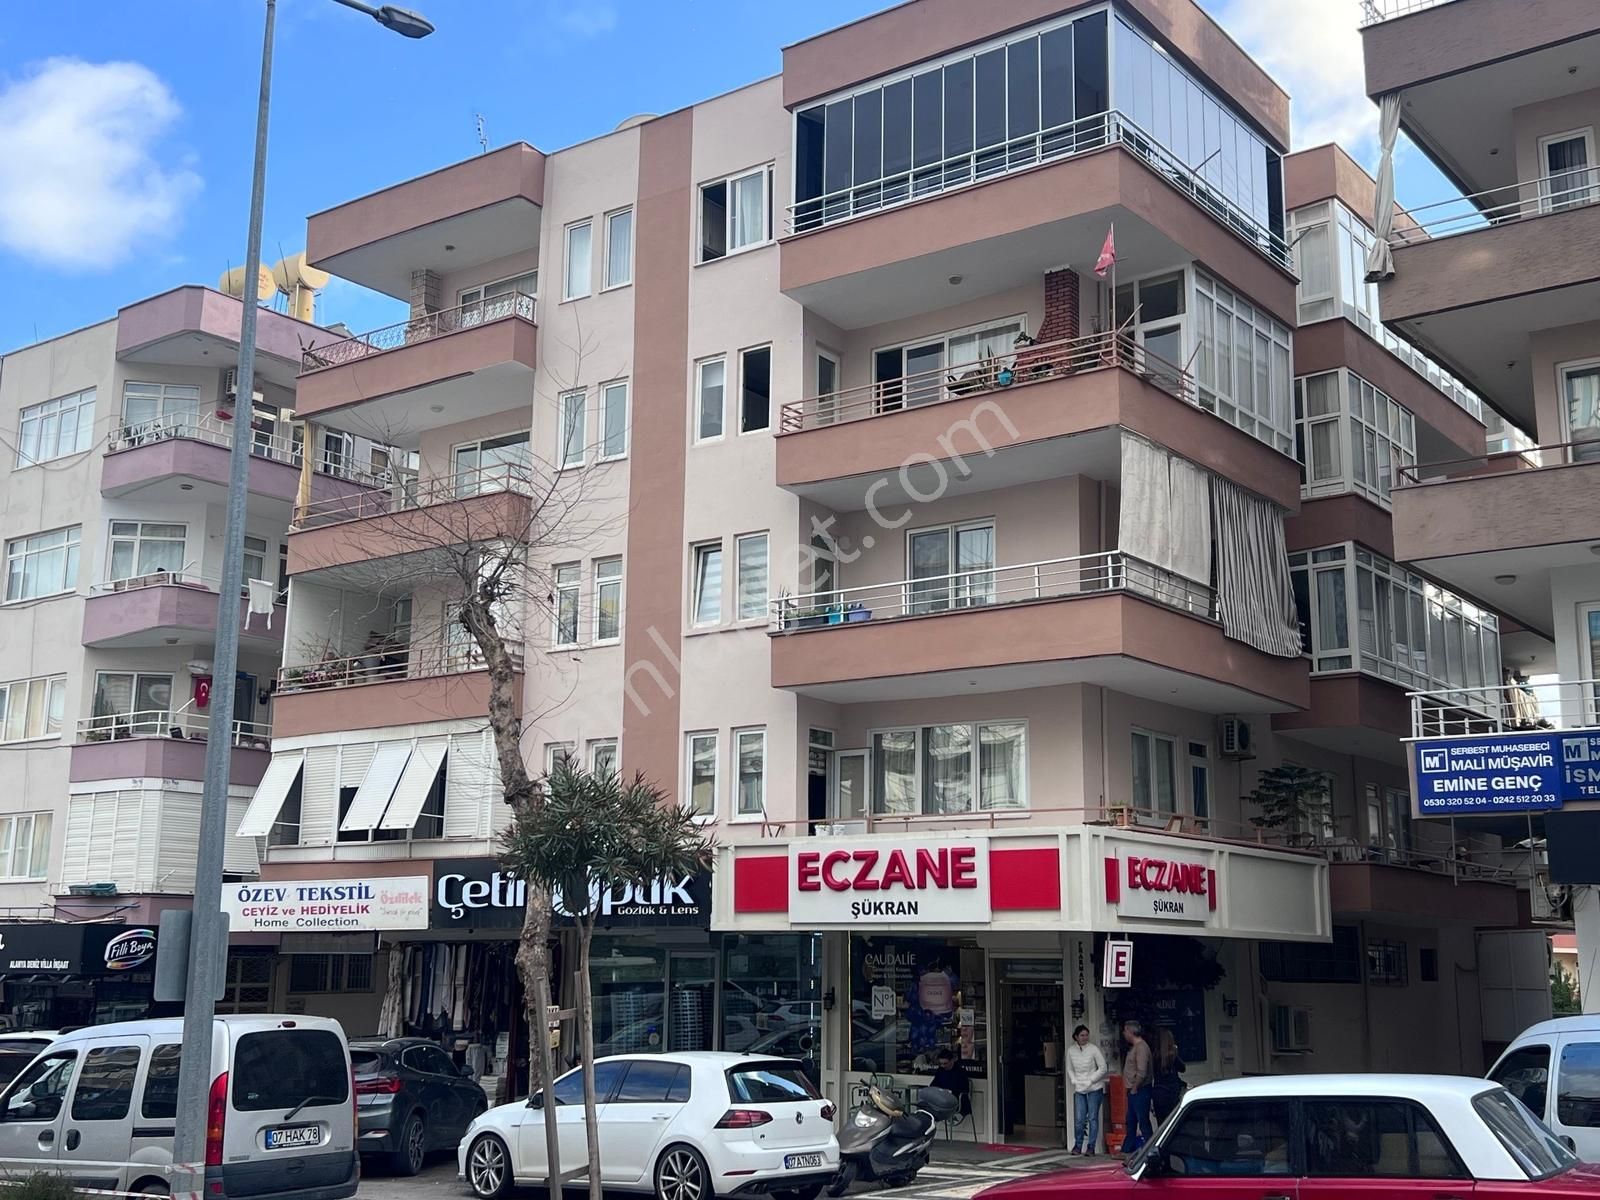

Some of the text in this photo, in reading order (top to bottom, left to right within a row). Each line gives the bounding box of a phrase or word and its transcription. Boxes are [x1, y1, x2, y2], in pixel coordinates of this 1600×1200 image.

[1450, 742, 1550, 756] SERBEST MUHASEBECİ
[1451, 754, 1553, 771] MALİ MÜŞAVİR
[1434, 775, 1542, 792] EMİNE GENÇ
[1424, 798, 1446, 806] 0530
[1446, 798, 1462, 806] 320
[1493, 796, 1514, 804] 0242
[1544, 794, 1555, 802] 33
[798, 848, 977, 891] ECZANE
[1128, 856, 1206, 895] ECZANE
[238, 882, 376, 902] ÖZEV TEKSTİL
[242, 904, 278, 916] CEYİZ
[282, 908, 296, 916] ve
[301, 904, 370, 915] HEDİYELİK
[659, 906, 667, 914] &
[671, 906, 699, 914] Lens
[851, 899, 918, 919] ŞÜKRAN
[1154, 899, 1184, 914] ŞÜKRAN
[254, 917, 358, 928] Home Collection
[111, 940, 154, 959] Filli Boya
[1115, 952, 1126, 977] E
[272, 1128, 318, 1144] 07 HAK 78
